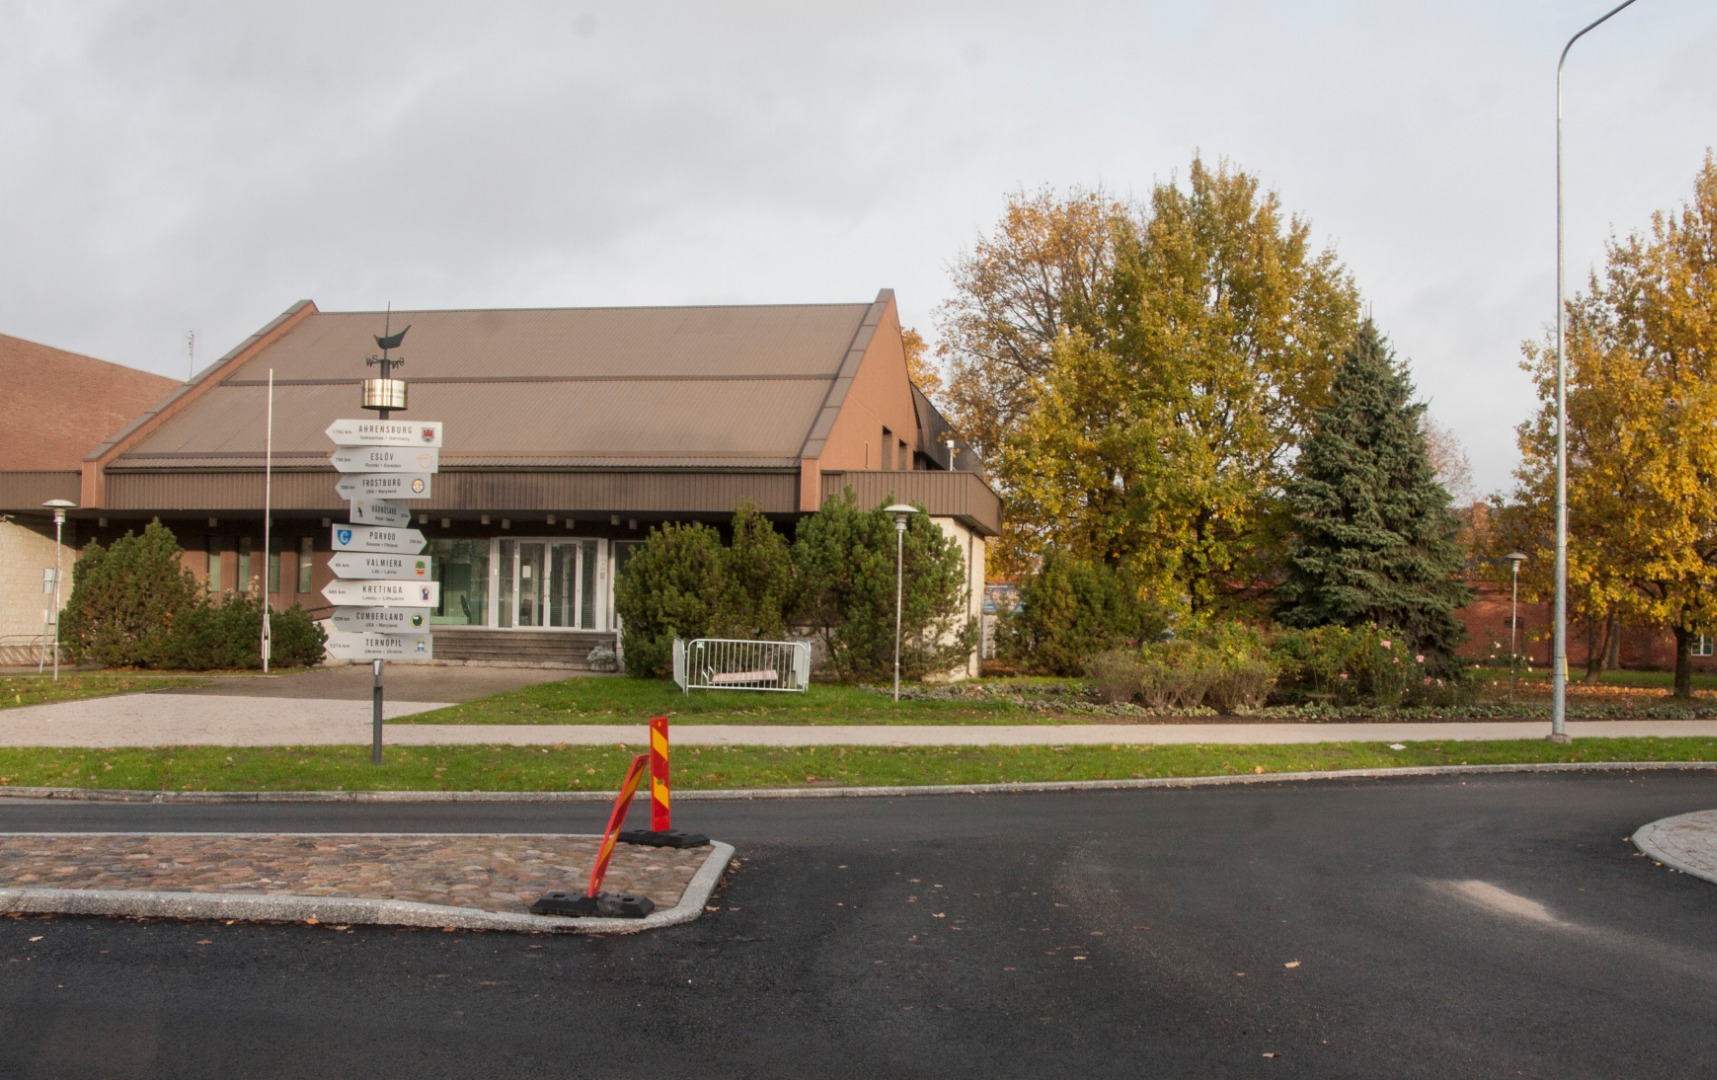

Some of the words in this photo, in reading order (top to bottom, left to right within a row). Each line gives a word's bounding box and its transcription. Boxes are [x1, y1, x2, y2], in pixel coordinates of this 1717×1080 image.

[358, 425, 413, 434] AHRENSBURG
[370, 452, 394, 461] ESLÖV
[362, 478, 401, 487] FROSTBURG
[369, 531, 396, 540] PORVOO
[366, 558, 402, 568] VALMIERA
[362, 585, 403, 594] KRETINGA
[356, 612, 404, 621] CUMBERLAND
[366, 639, 402, 647] TERNOPIL
